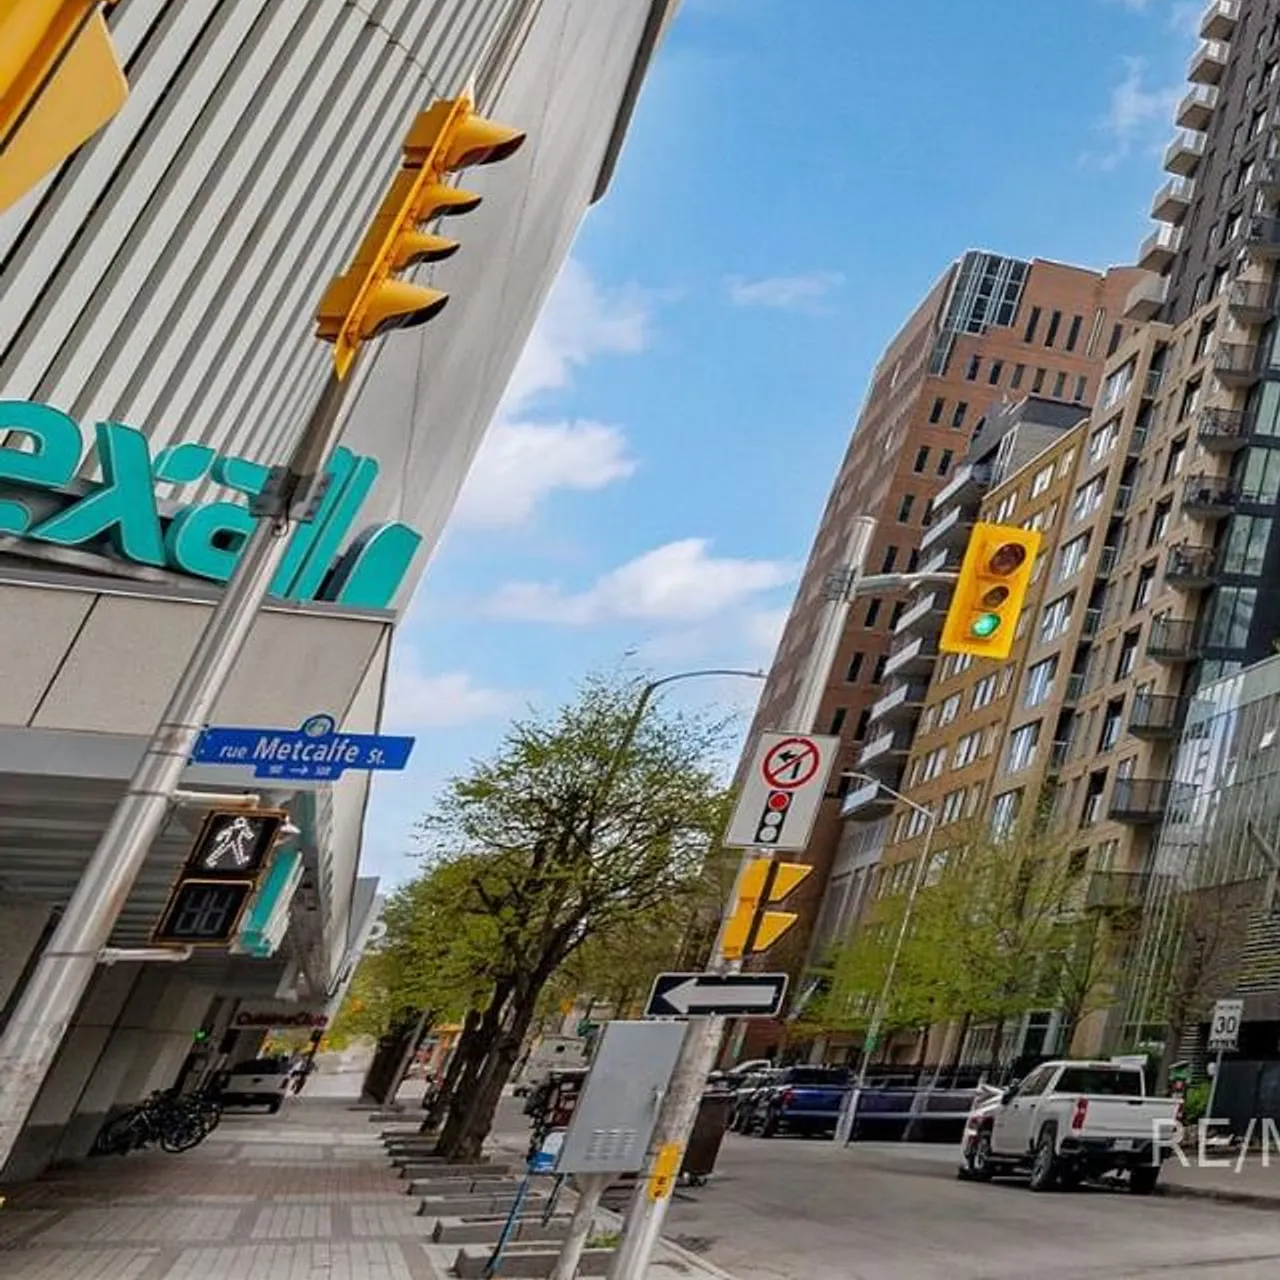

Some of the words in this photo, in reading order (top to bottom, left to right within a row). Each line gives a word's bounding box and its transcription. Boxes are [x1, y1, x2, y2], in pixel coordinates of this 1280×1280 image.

[219, 745, 248, 759] rue
[252, 736, 360, 764] Metcalfe
[366, 748, 386, 765] St.
[1215, 1016, 1237, 1034] 30
